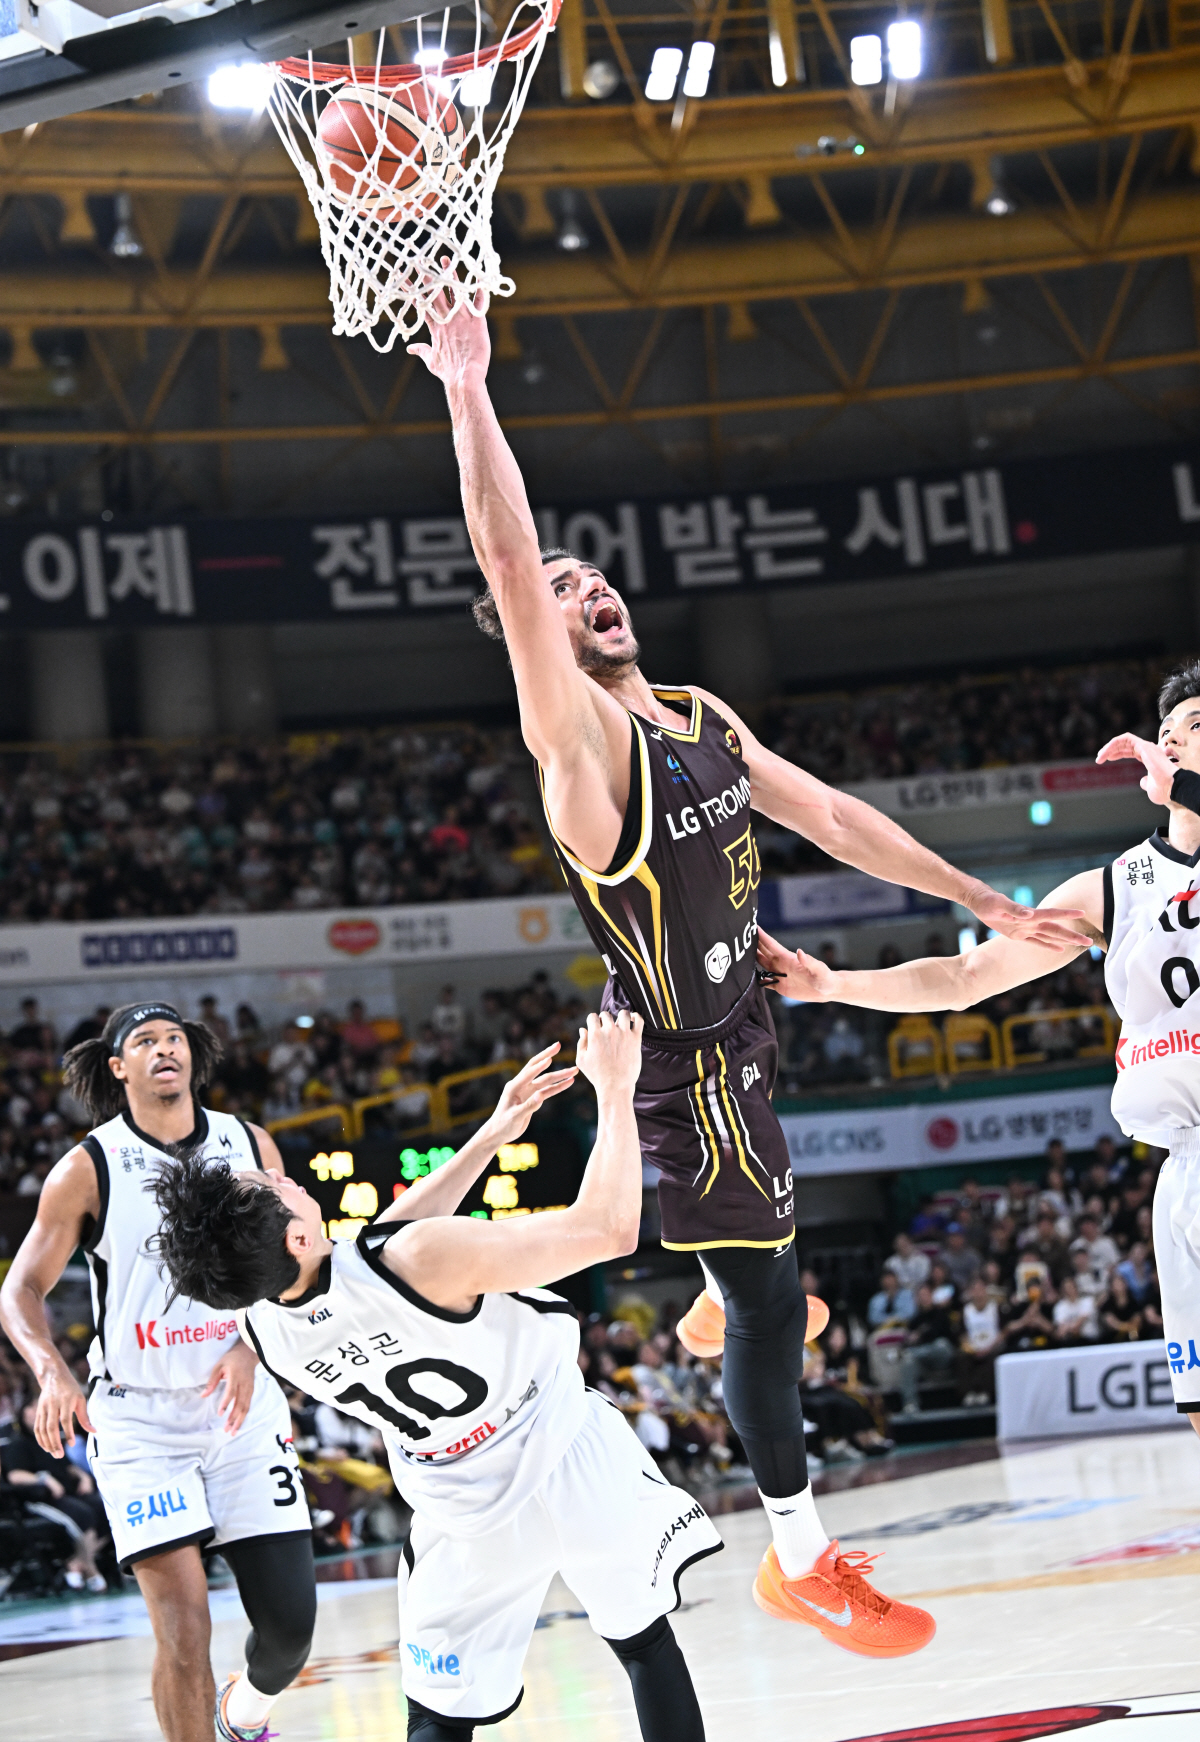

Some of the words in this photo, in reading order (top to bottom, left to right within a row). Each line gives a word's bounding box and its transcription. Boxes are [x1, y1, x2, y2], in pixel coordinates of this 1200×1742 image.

[22, 524, 196, 619] 이제
[311, 504, 647, 610] 전문어
[657, 495, 828, 588] 받는
[665, 806, 702, 840] LG
[1126, 855, 1154, 873] 모나
[1160, 956, 1200, 1009] 0
[772, 1167, 794, 1199] LG
[134, 1320, 161, 1350] K
[164, 1318, 239, 1347] intellige
[307, 1306, 334, 1326] KBL
[304, 1331, 403, 1384] 문성곤
[333, 1356, 489, 1442] 10
[268, 1464, 304, 1507] 3
[126, 1486, 188, 1528] 유사나
